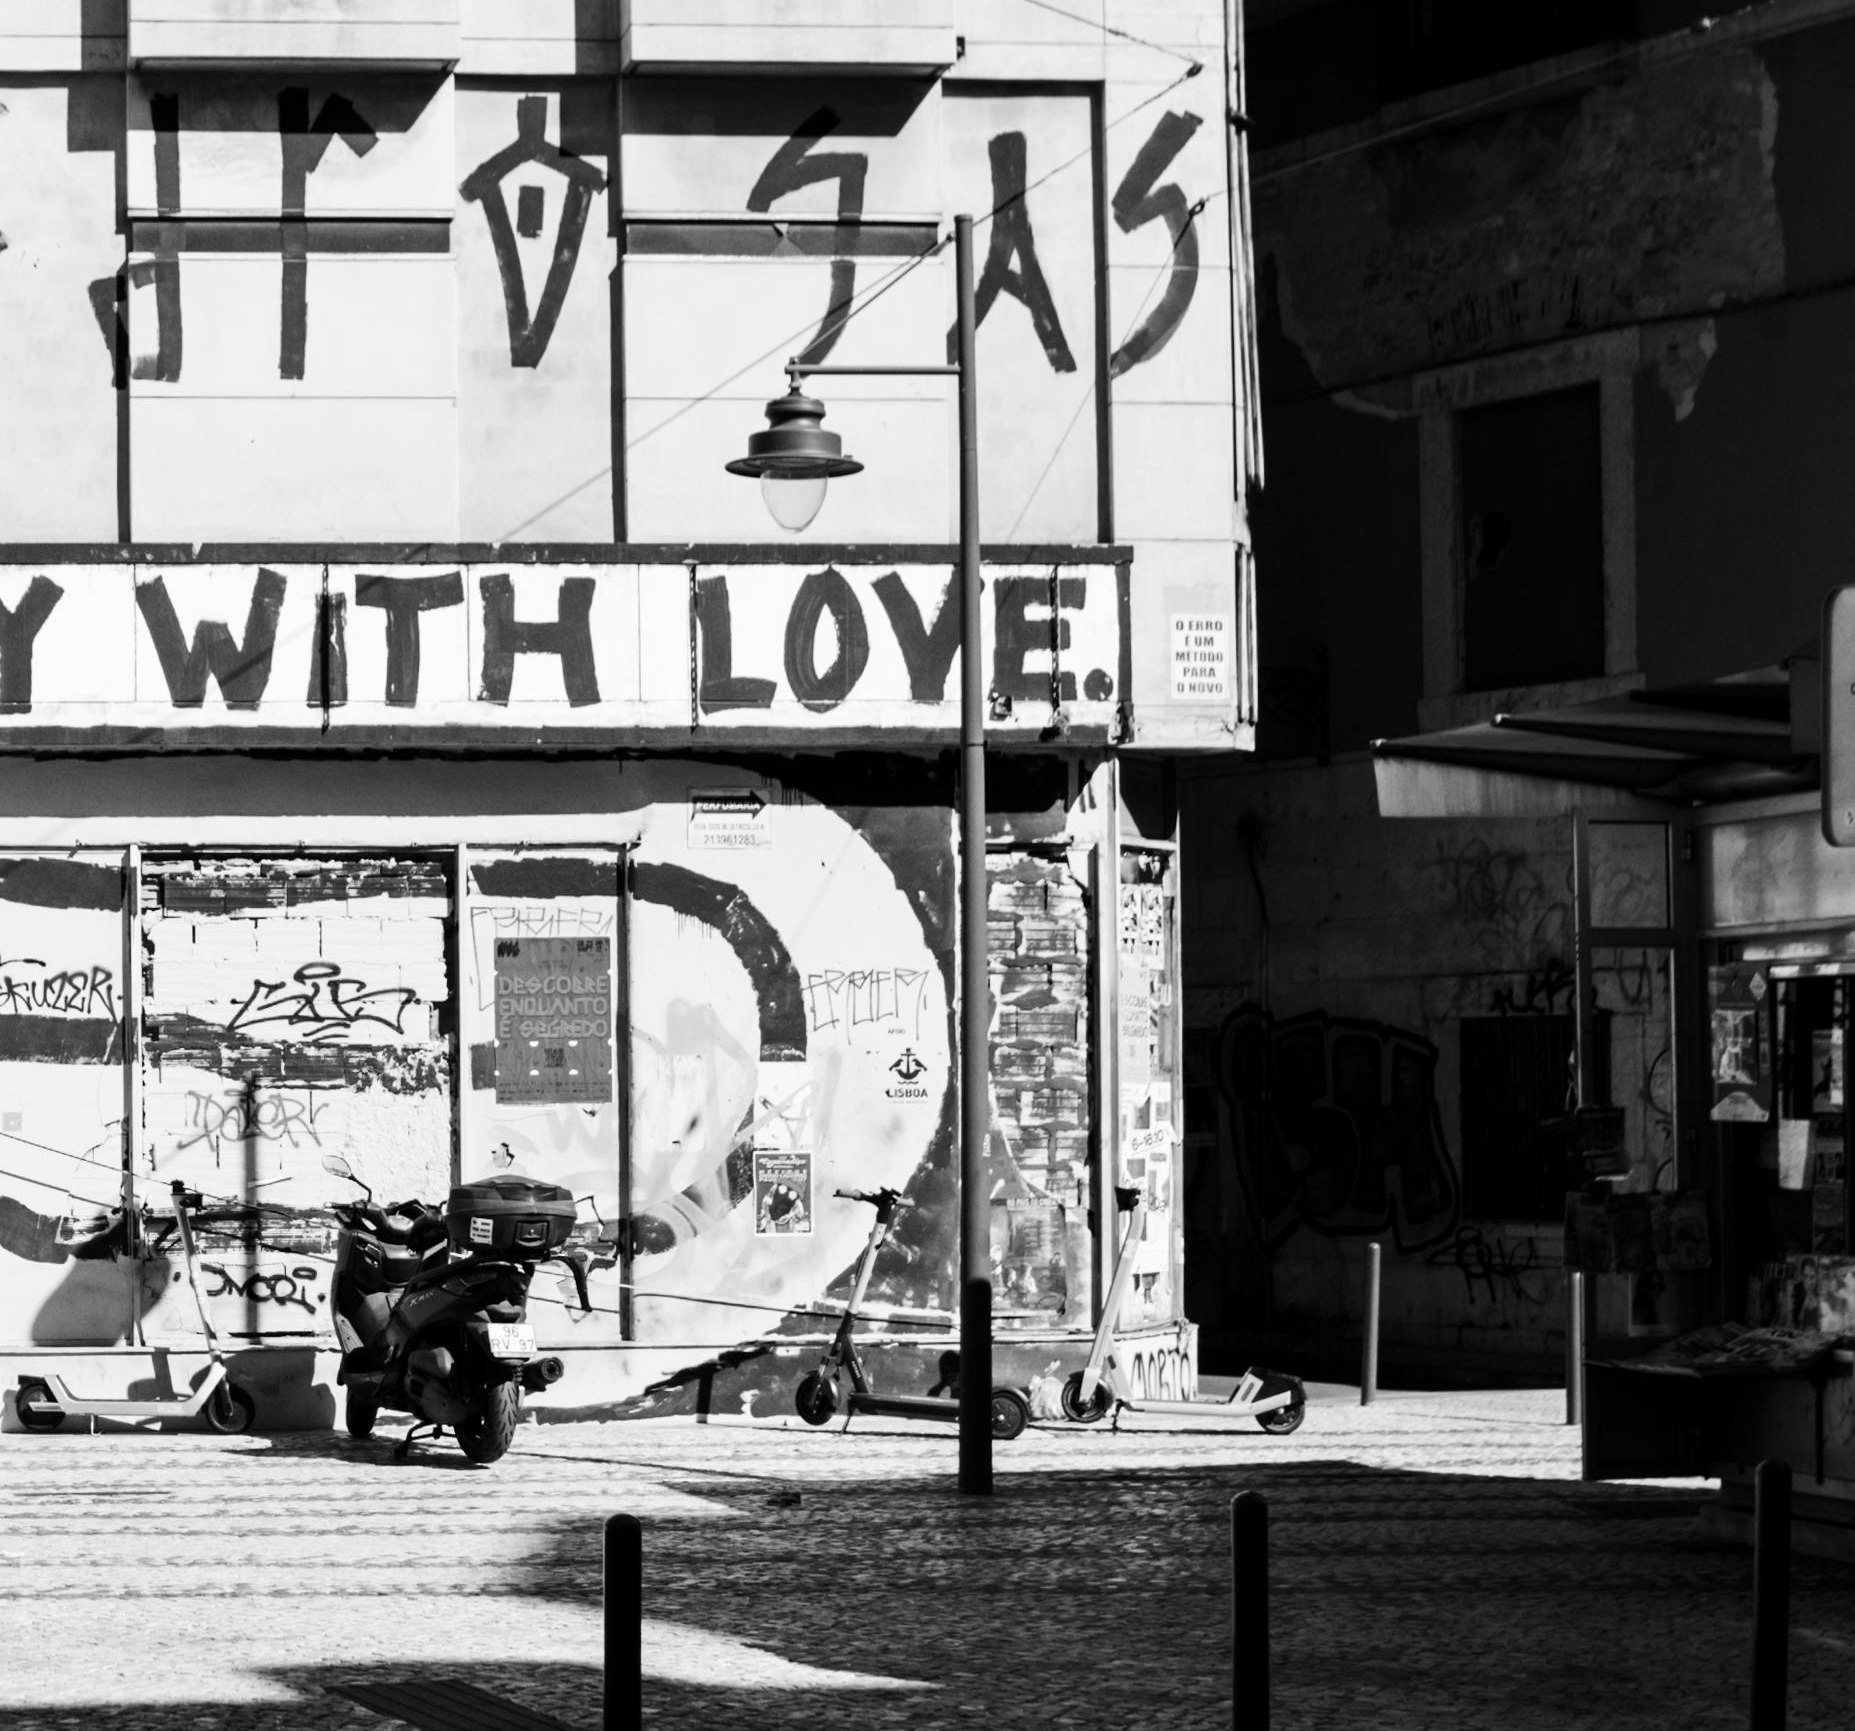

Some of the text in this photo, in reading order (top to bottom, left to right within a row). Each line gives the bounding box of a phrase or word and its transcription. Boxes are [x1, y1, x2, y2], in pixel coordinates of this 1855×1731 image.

[1188, 620, 1224, 631] ERRO
[134, 567, 603, 712] WITH
[699, 564, 1116, 717] LOVE.
[1194, 636, 1214, 647] UM
[1175, 649, 1224, 662] MÉTODO
[1183, 666, 1216, 677] PARA
[1188, 682, 1224, 693] NOVO
[498, 975, 608, 995] DESCOBRE
[498, 997, 608, 1016] ENQUANTO
[519, 1018, 608, 1039] SEGREDO
[885, 1088, 929, 1098] LISBOA
